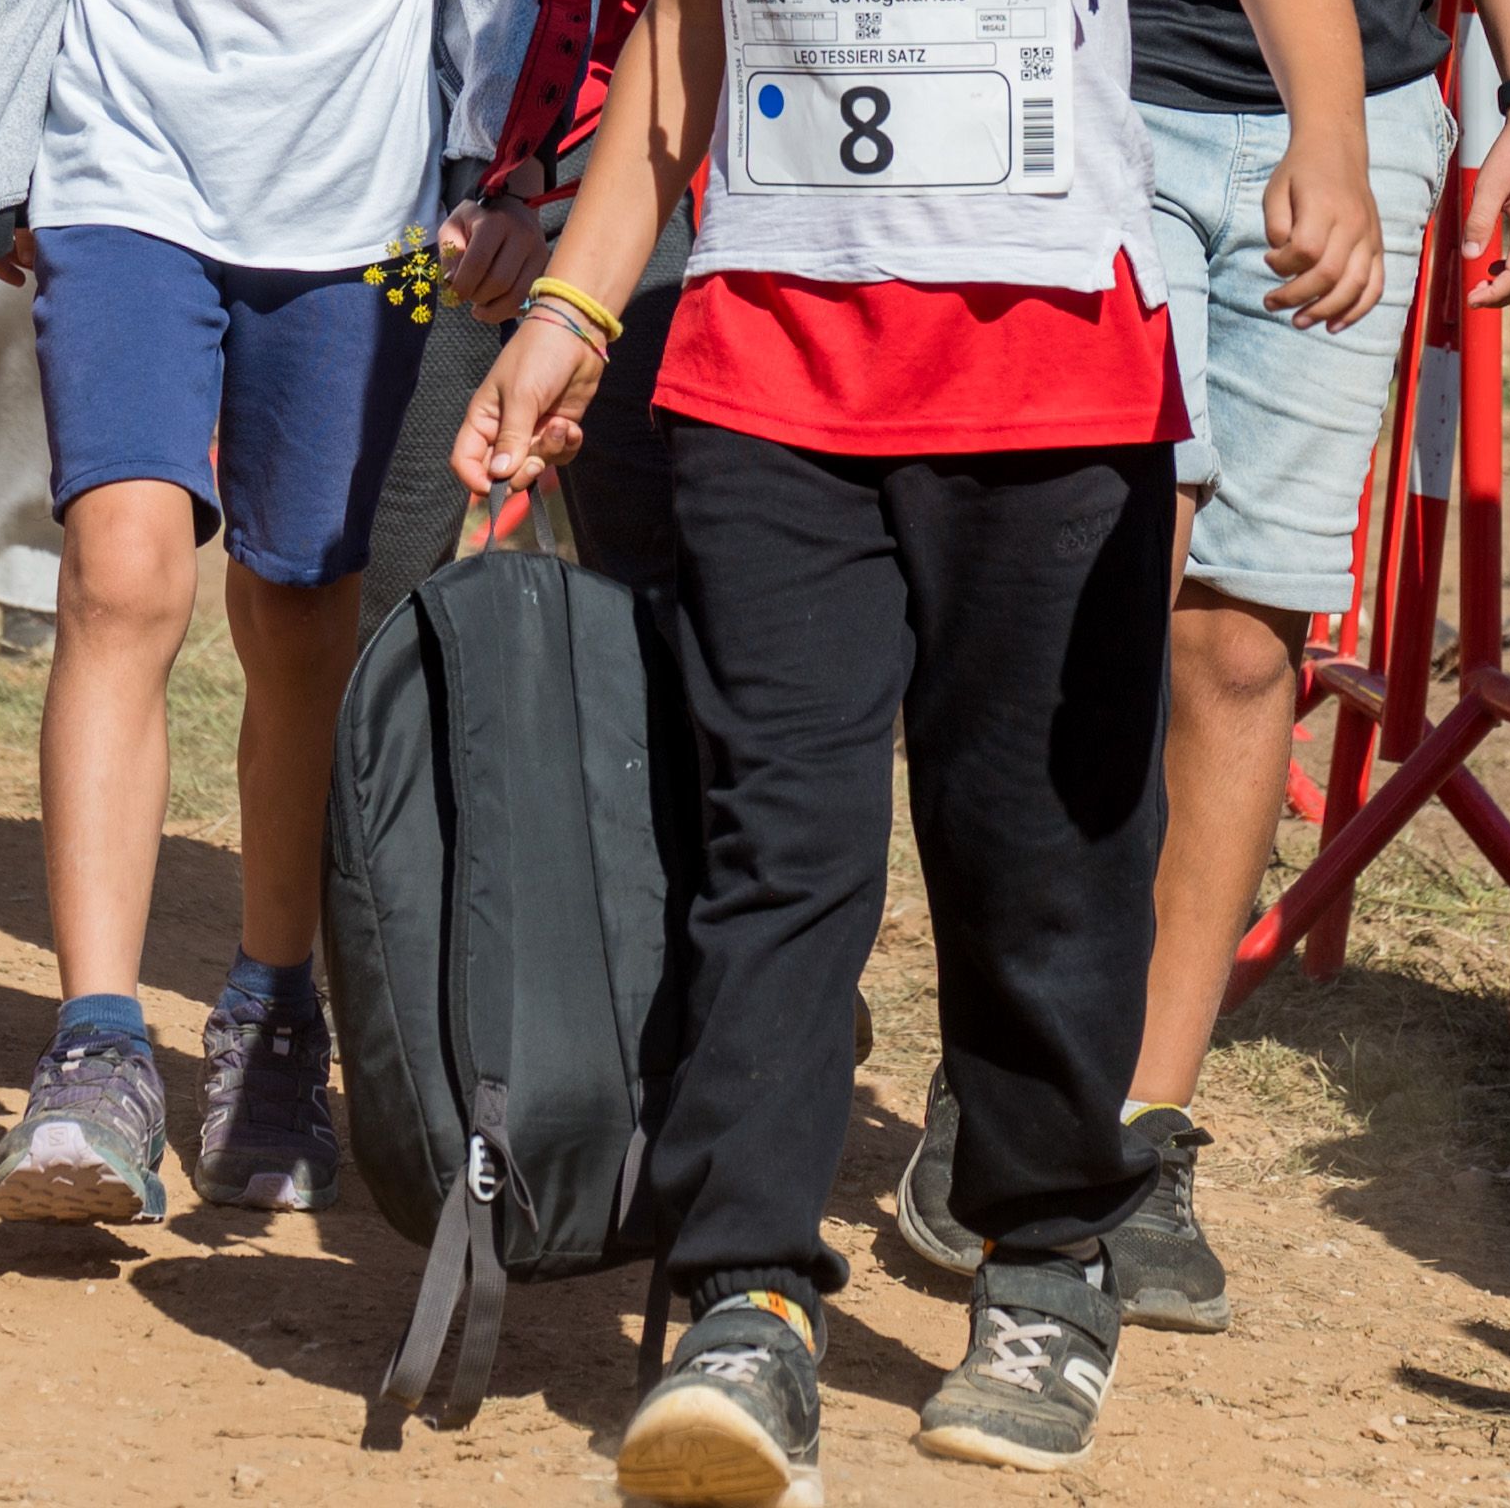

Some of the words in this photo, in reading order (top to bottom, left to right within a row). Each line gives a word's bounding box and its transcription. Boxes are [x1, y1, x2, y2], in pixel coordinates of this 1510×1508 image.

[979, 14, 1007, 22] CONTROL
[793, 50, 817, 64] LEO
[820, 49, 883, 64] TESSIERI
[887, 48, 926, 64] SATZ
[839, 86, 894, 175] 8
